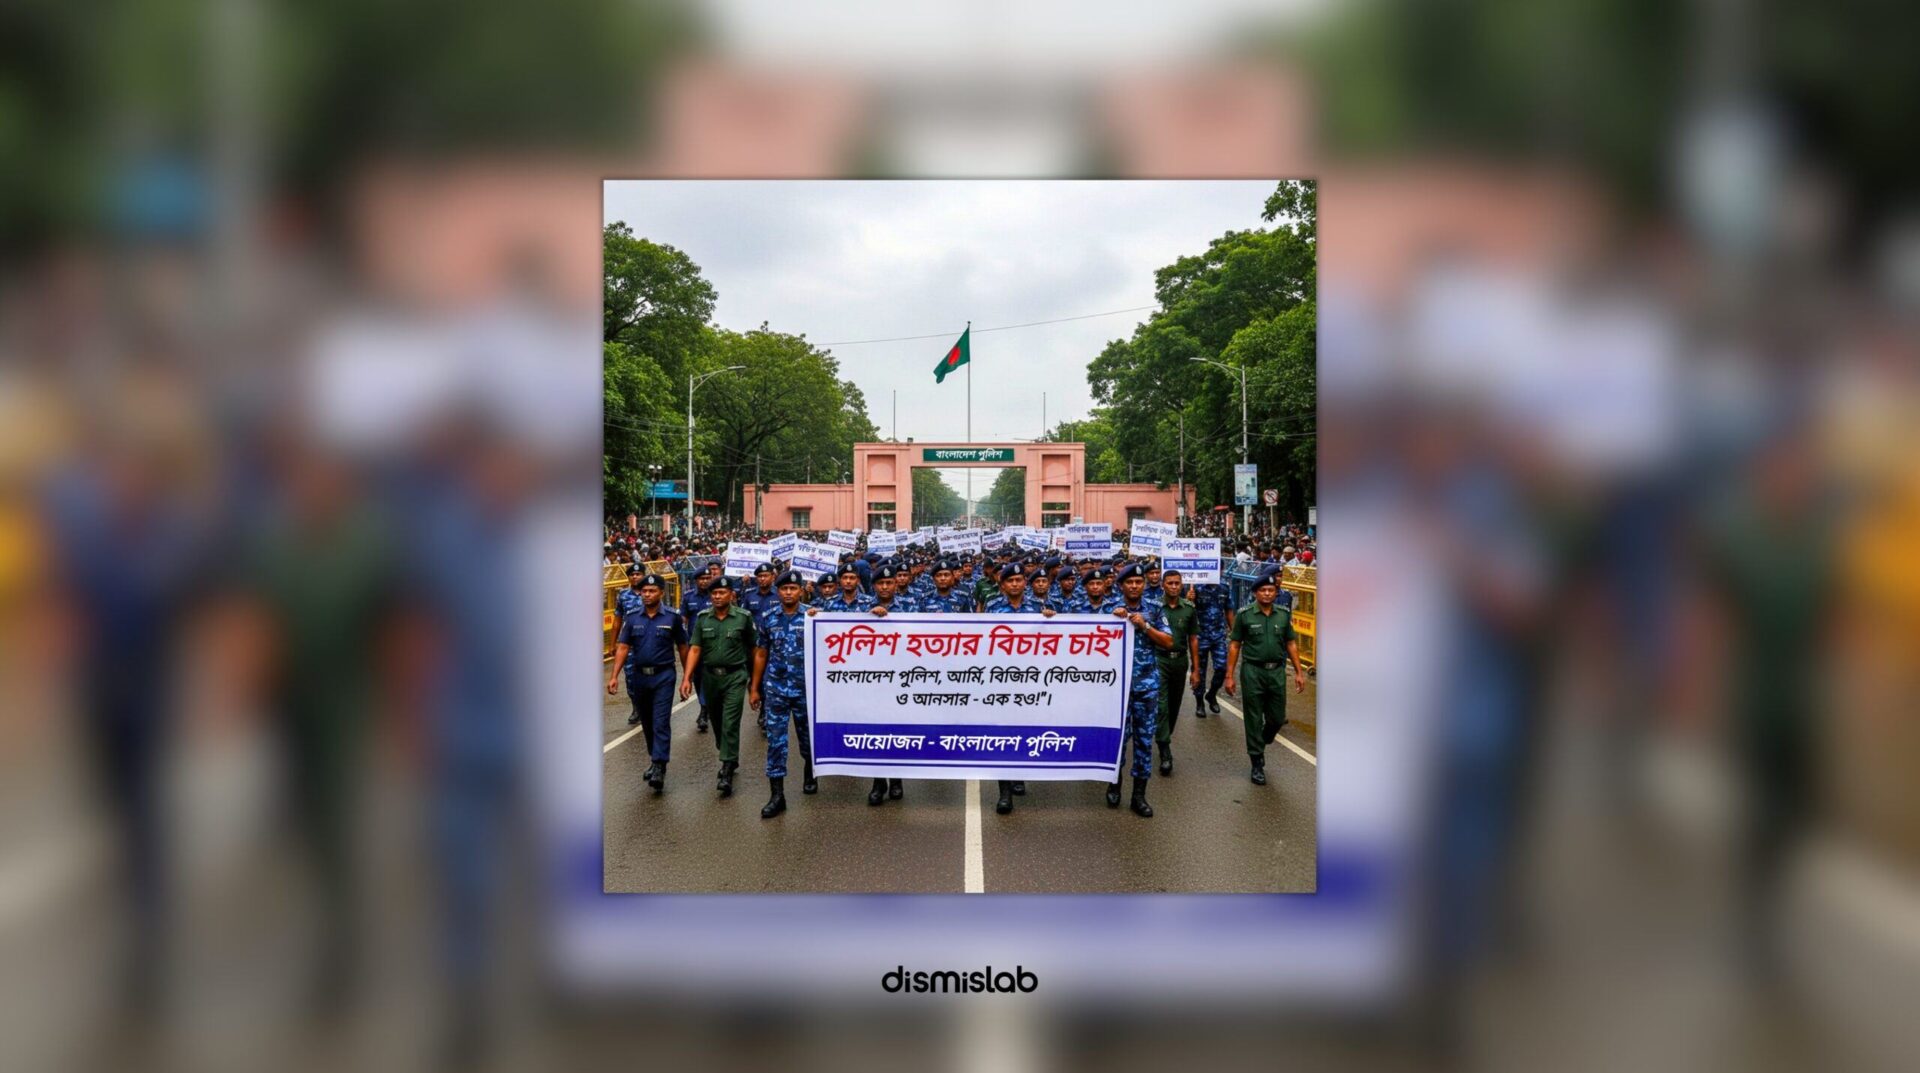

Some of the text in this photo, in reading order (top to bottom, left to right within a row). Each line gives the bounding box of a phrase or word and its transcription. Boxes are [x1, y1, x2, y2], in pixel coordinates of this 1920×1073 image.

[935, 447, 1003, 461] বাংলাদেশ পুলিশ
[824, 624, 901, 664] পুলিশ
[906, 632, 983, 657] হত্যার
[988, 625, 1063, 656] বিচার
[827, 666, 1117, 688] বাংলাদেশ পুলিশ, আর্মি, বিজিবি (বিডিআর)
[896, 693, 908, 706] ও
[912, 693, 971, 706] আনসার
[982, 693, 1011, 706] এক
[843, 733, 925, 750] আয়োজন
[939, 734, 1022, 752] বাংলাদেশ
[1026, 730, 1077, 757] পুলিশ
